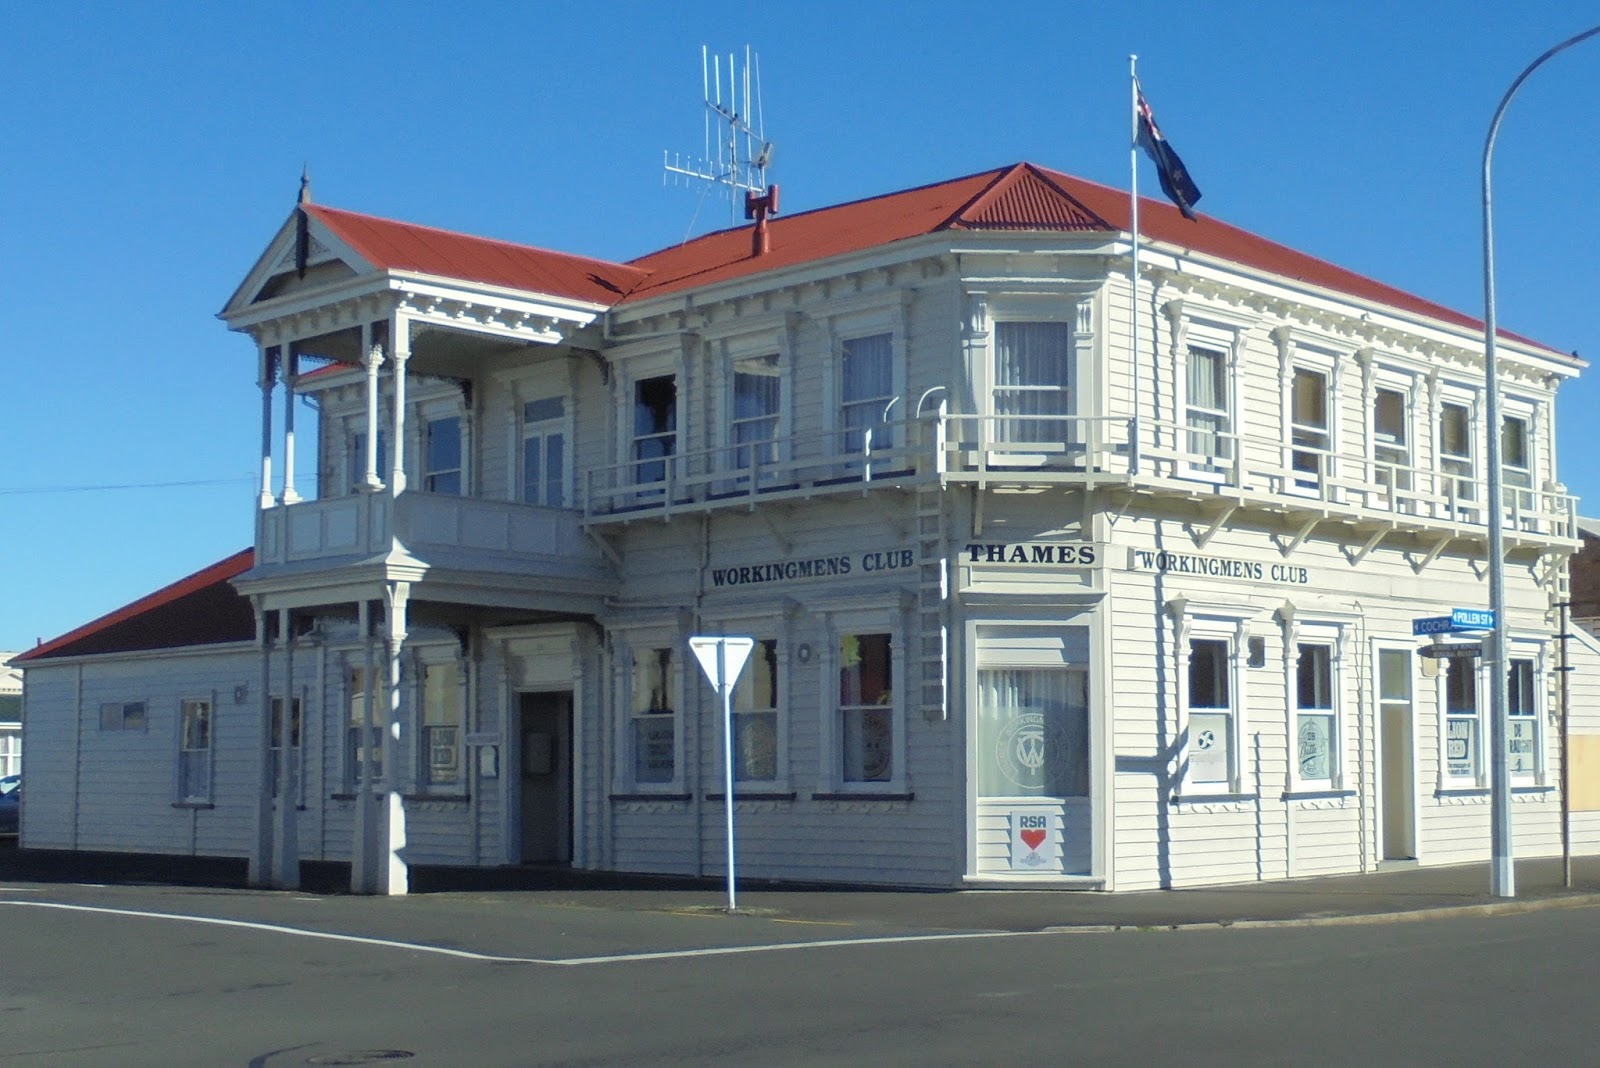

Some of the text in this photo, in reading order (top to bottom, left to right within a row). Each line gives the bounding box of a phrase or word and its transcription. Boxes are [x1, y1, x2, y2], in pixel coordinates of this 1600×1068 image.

[965, 544, 1095, 565] THAMES
[713, 550, 914, 587] WORKINGMENS CLUB
[1141, 551, 1308, 584] WORKINGMENS CLUB
[1421, 620, 1453, 633] COCHR
[1458, 612, 1489, 625] POLLEN ST
[1020, 815, 1047, 828] RSA
